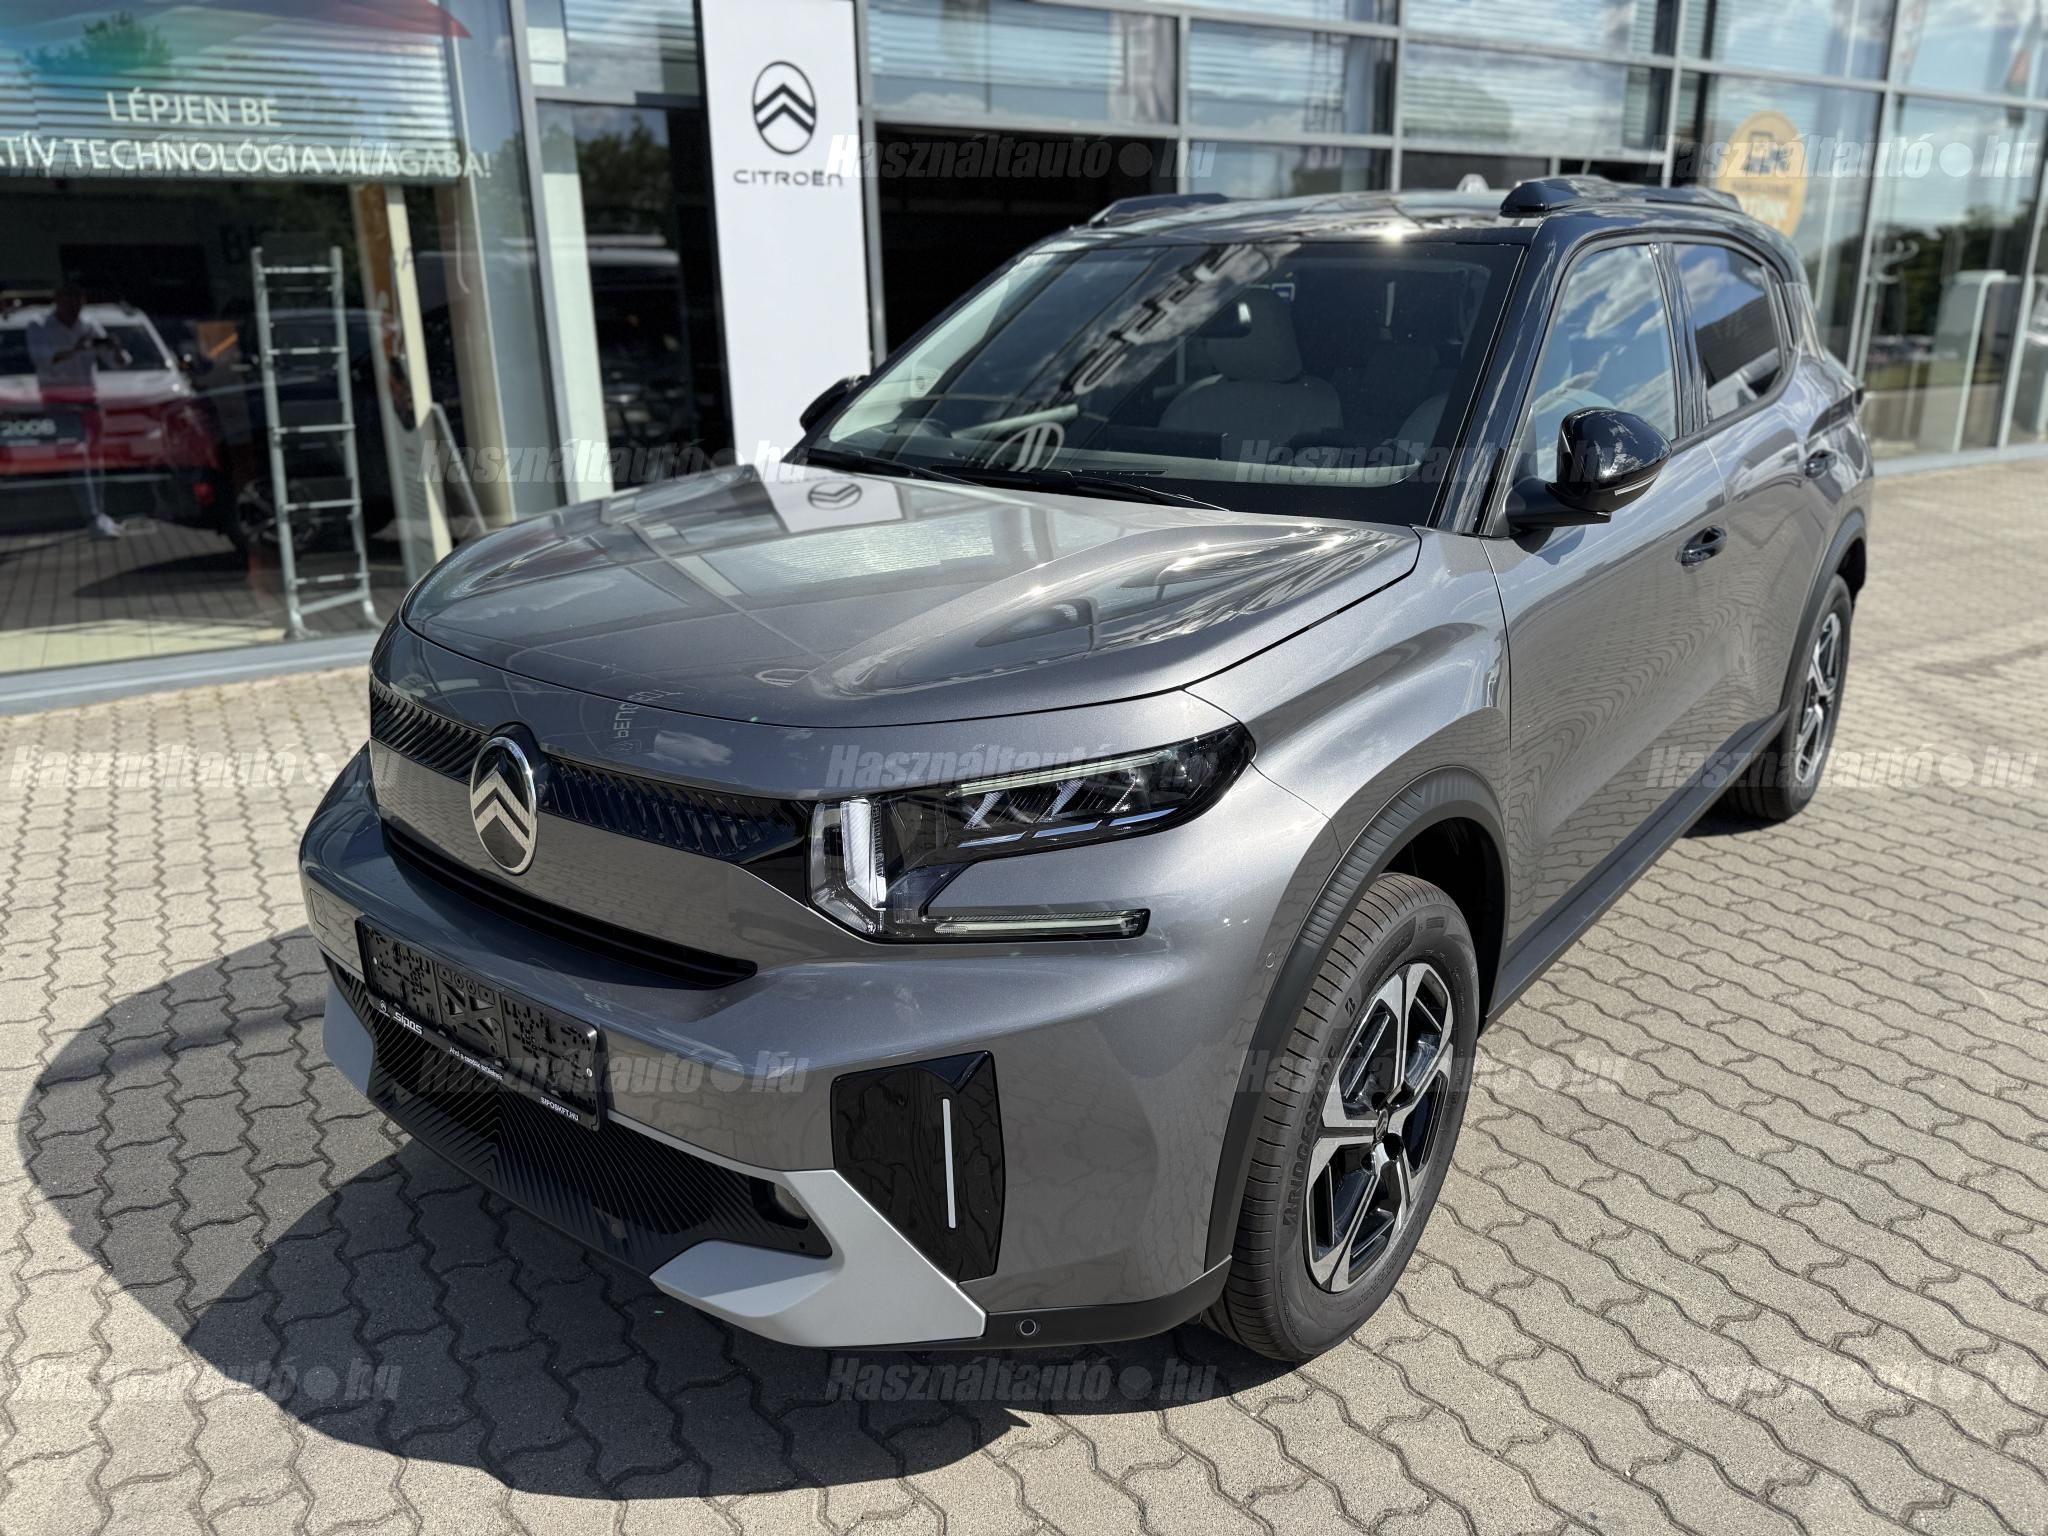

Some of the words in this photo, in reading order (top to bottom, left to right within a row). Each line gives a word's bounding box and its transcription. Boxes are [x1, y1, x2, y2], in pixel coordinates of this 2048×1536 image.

[106, 86, 229, 125] LÉPJEN
[241, 97, 282, 127] BE
[0, 131, 57, 168] TÍV
[63, 137, 323, 174] TECHNOLÓGIA
[393, 1011, 423, 1034] sipos
